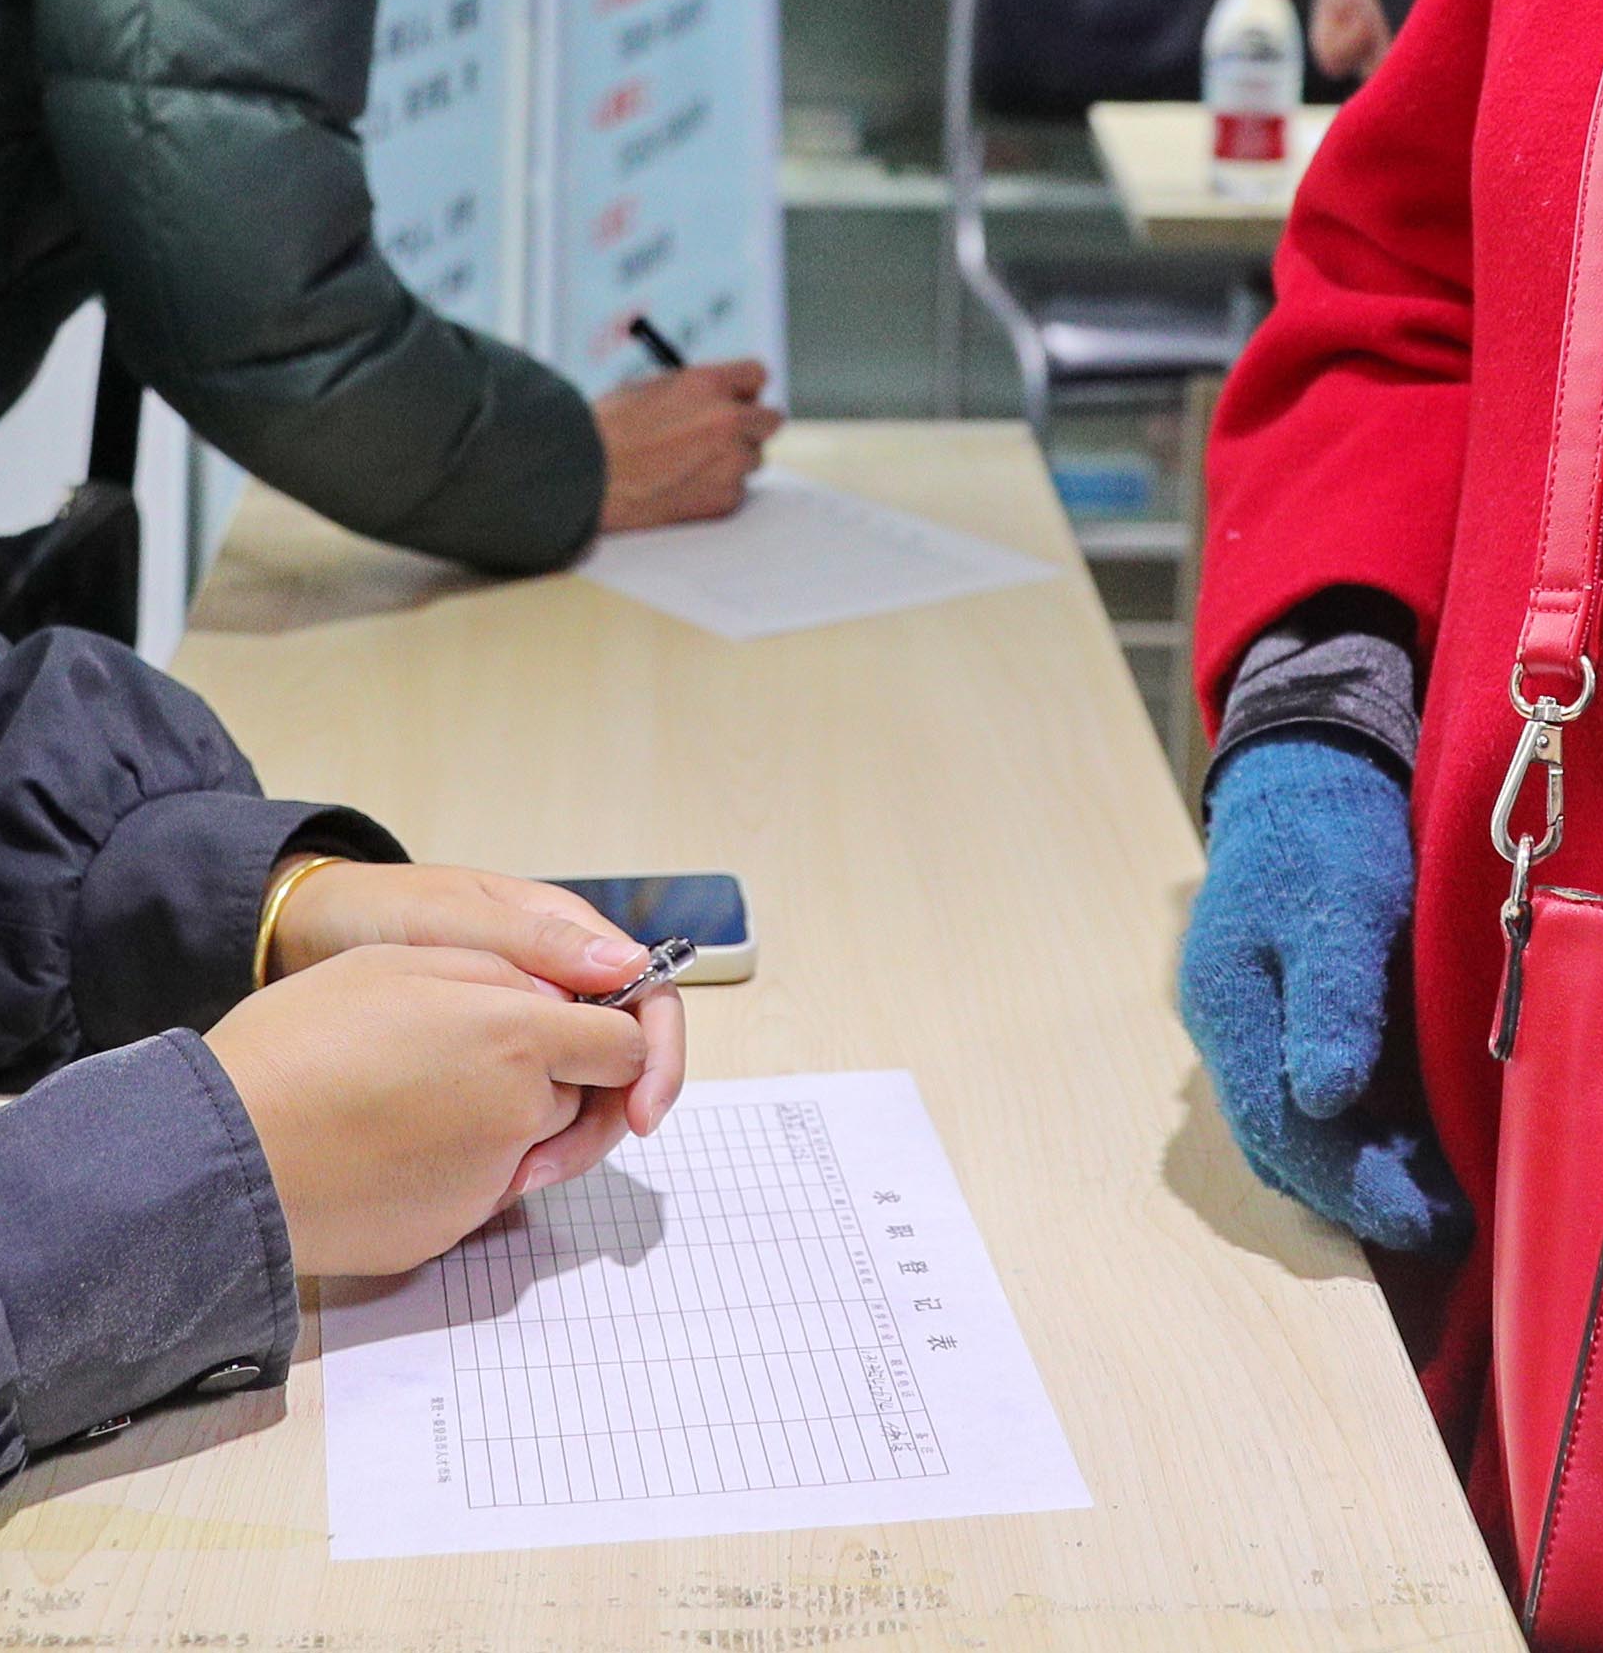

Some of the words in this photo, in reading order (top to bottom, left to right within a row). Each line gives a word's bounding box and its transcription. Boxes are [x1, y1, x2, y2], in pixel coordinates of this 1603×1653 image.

[873, 1191, 958, 1351] 求职登记表
